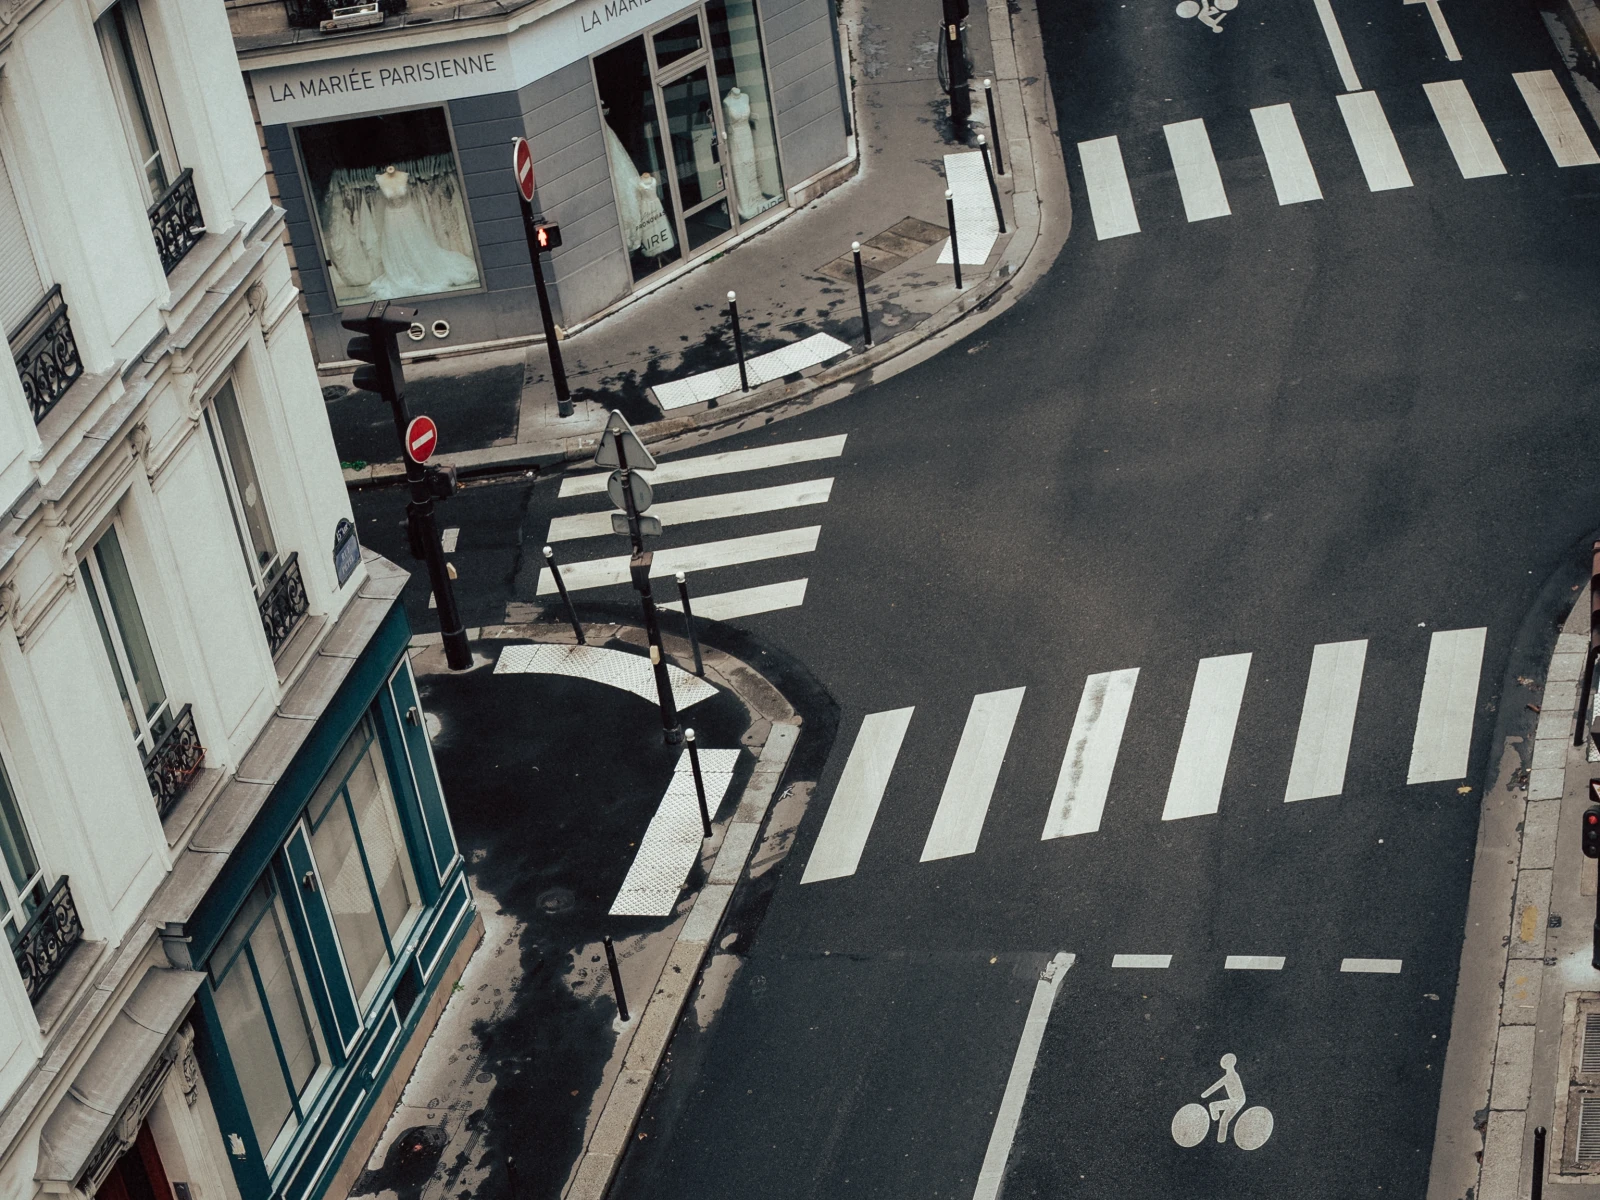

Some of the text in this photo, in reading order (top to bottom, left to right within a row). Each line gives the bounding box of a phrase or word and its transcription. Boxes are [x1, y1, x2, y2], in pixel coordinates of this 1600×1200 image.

[581, 10, 602, 33] LA
[269, 53, 497, 103] LA MARIÉE PARISIENNE
